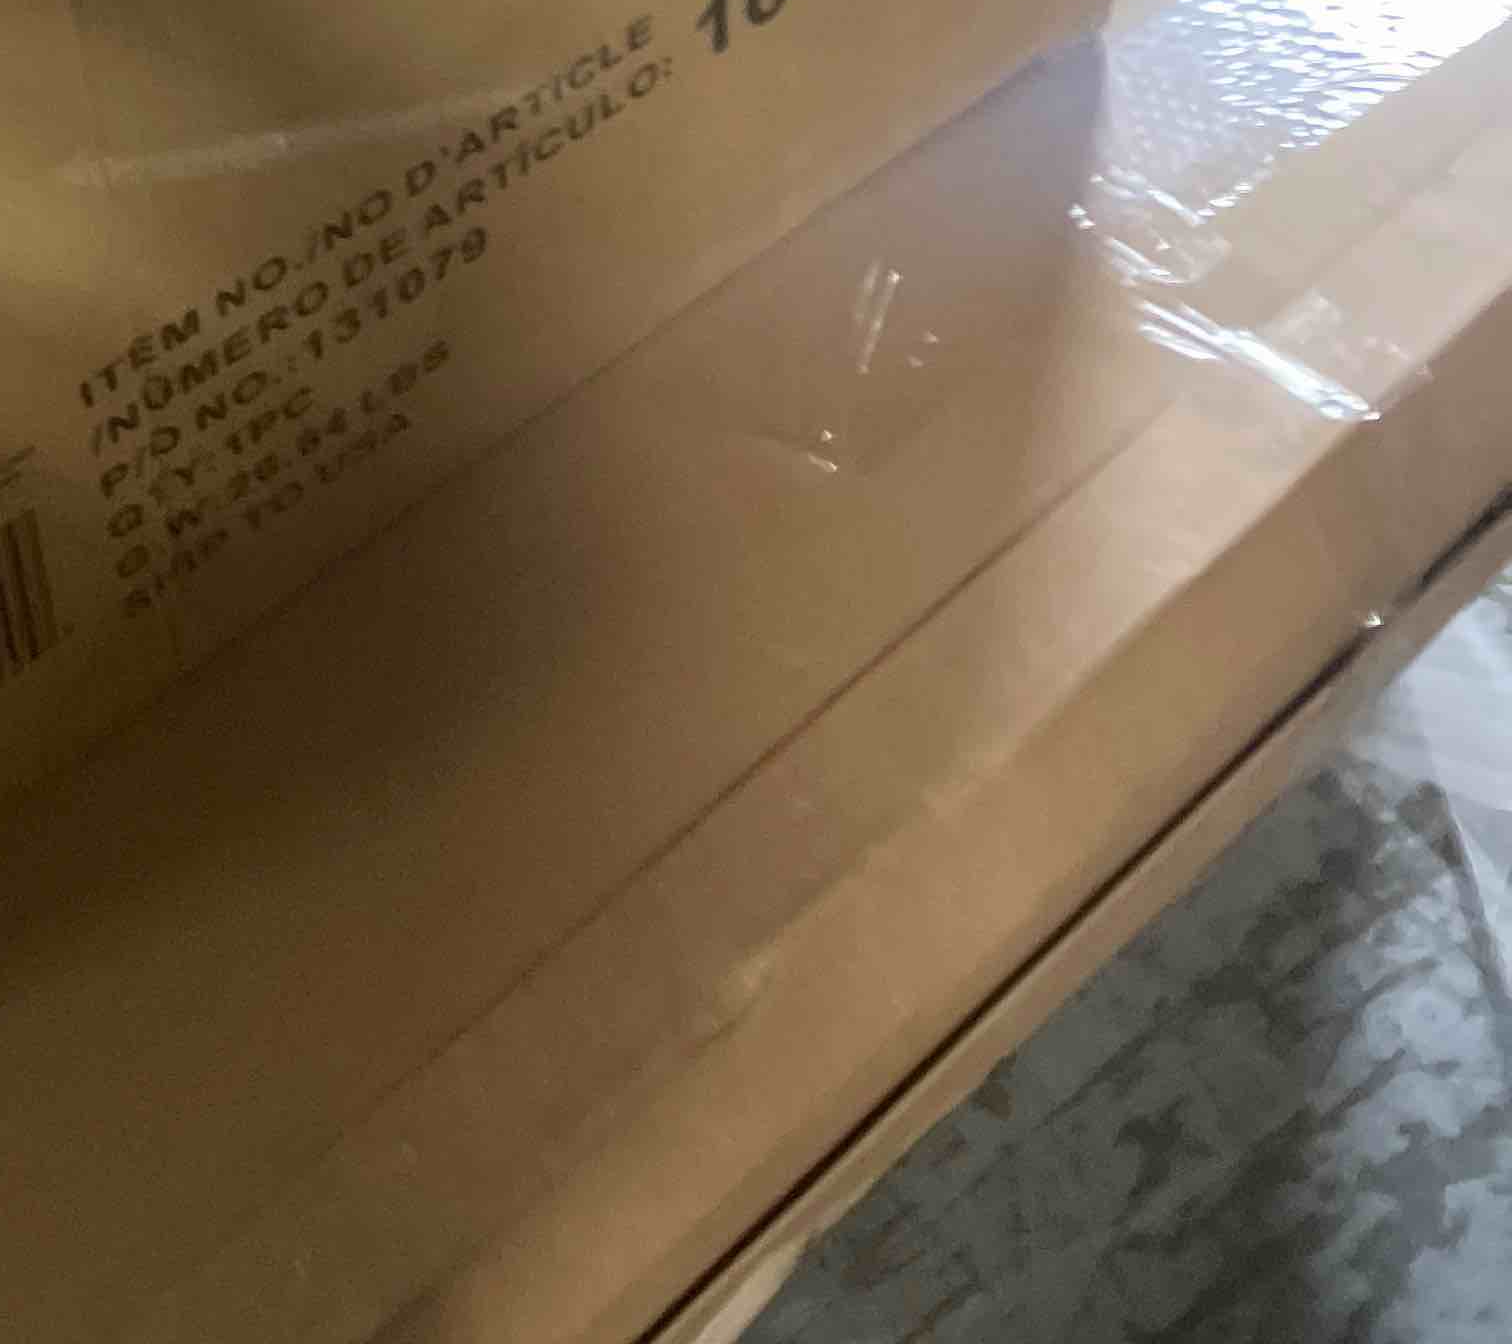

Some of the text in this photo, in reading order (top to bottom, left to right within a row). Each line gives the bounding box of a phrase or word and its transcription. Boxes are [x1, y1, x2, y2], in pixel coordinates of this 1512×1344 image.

[78, 308, 201, 410] ITEM
[403, 14, 656, 202] D'ARTICLE
[340, 227, 407, 291] DE
